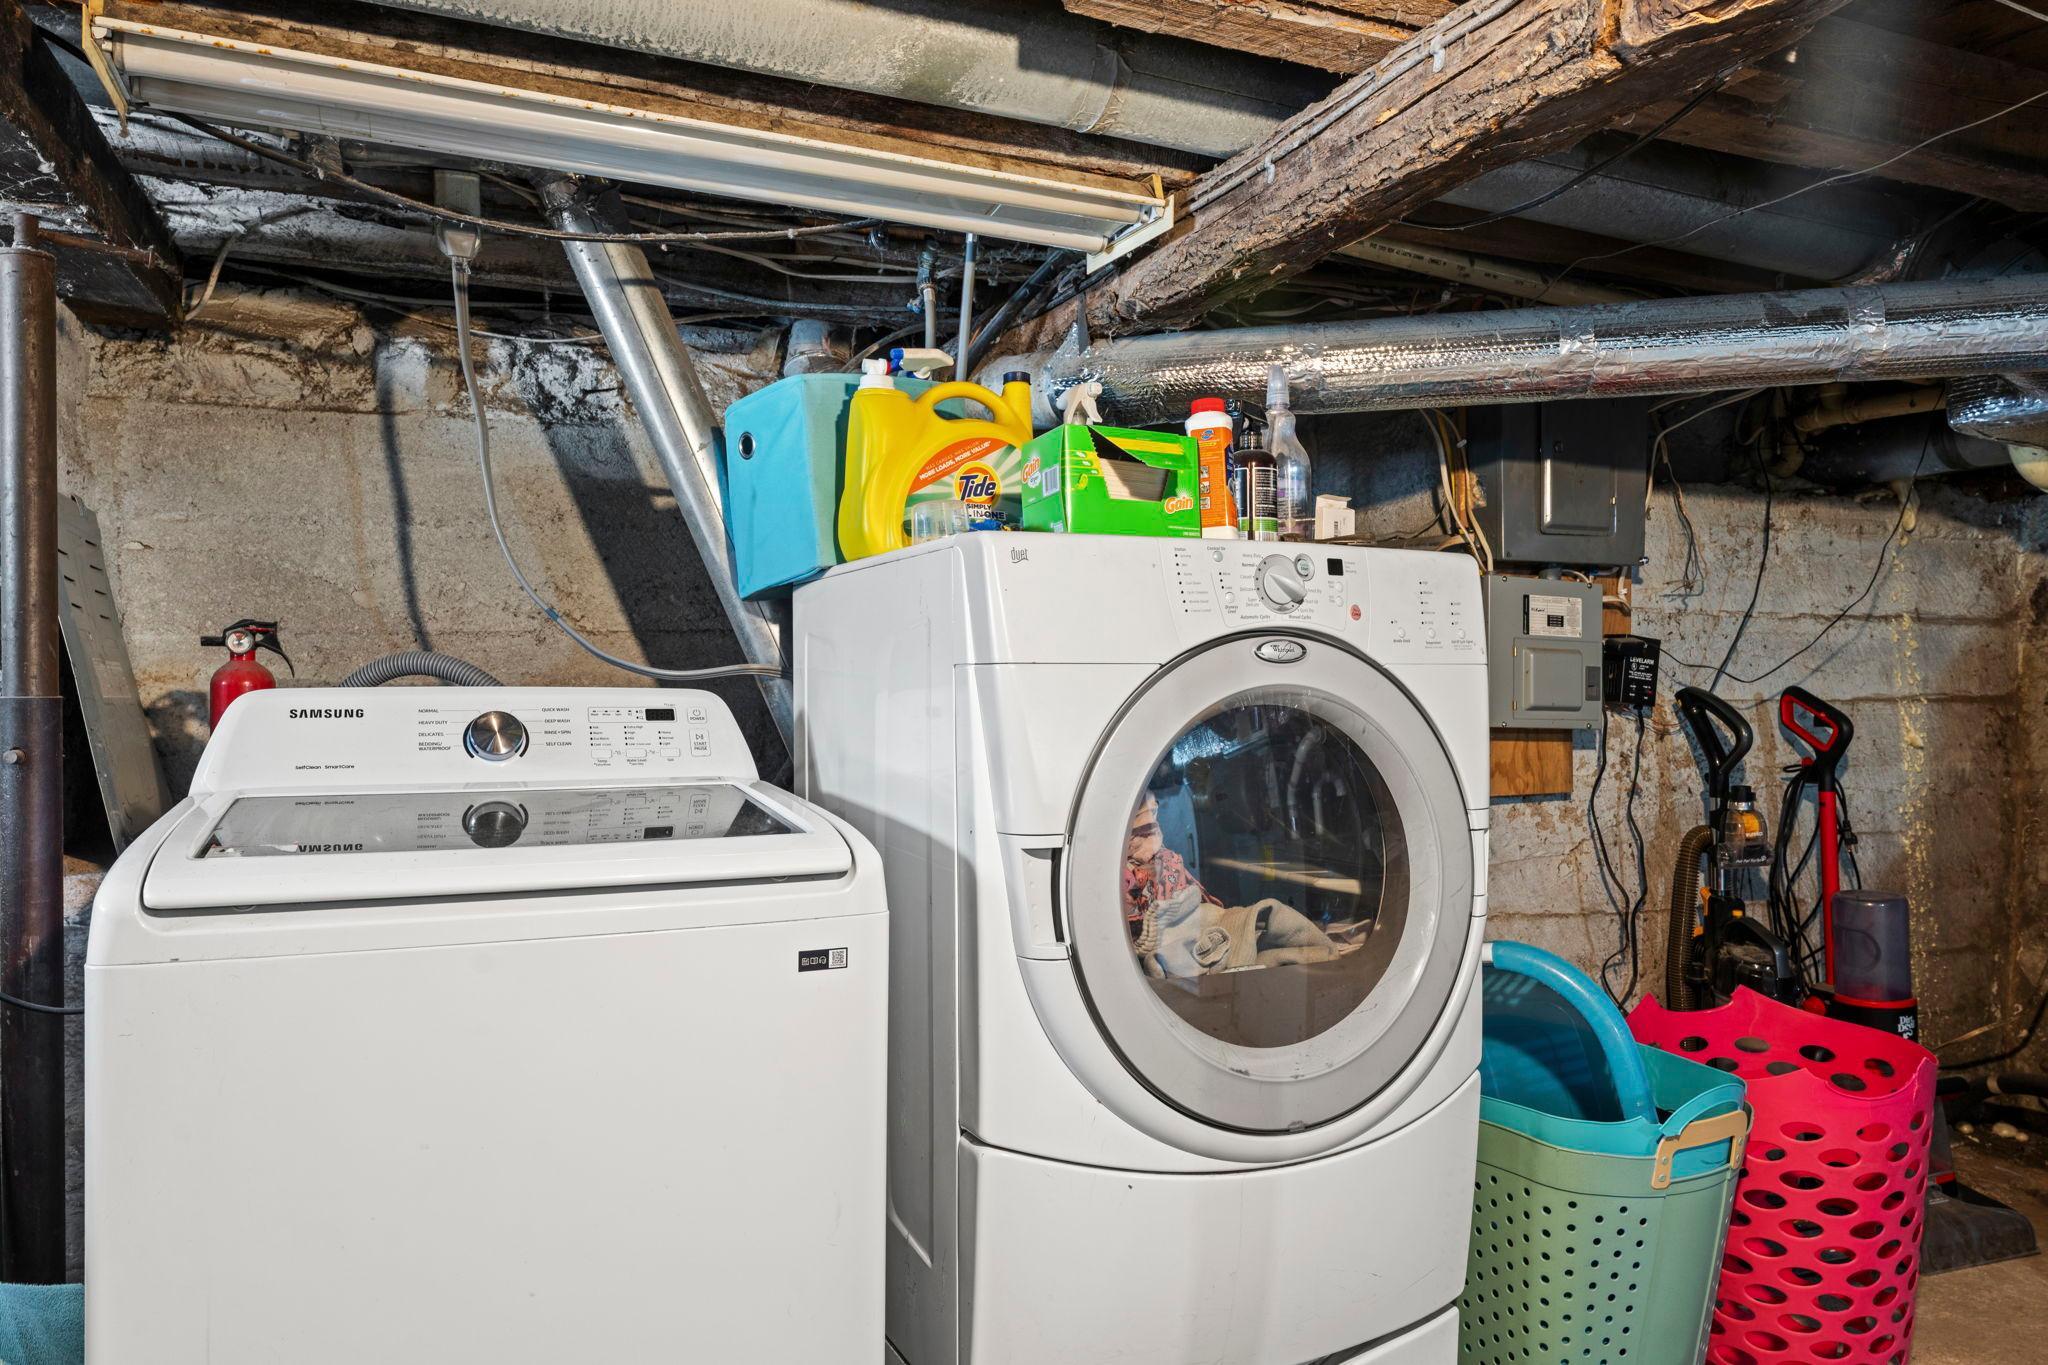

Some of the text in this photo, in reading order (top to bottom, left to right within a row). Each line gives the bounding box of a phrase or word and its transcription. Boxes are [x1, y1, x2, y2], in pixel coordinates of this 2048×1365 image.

[919, 469, 936, 480] MORE
[936, 460, 956, 473] LOADS,
[955, 452, 972, 462] MORE
[1022, 457, 1040, 482] Gain
[959, 475, 996, 502] Tide
[1165, 496, 1194, 514] Gain
[984, 511, 1005, 520] ONE
[1011, 547, 1028, 562] duet
[289, 709, 364, 719] SAMSUNG
